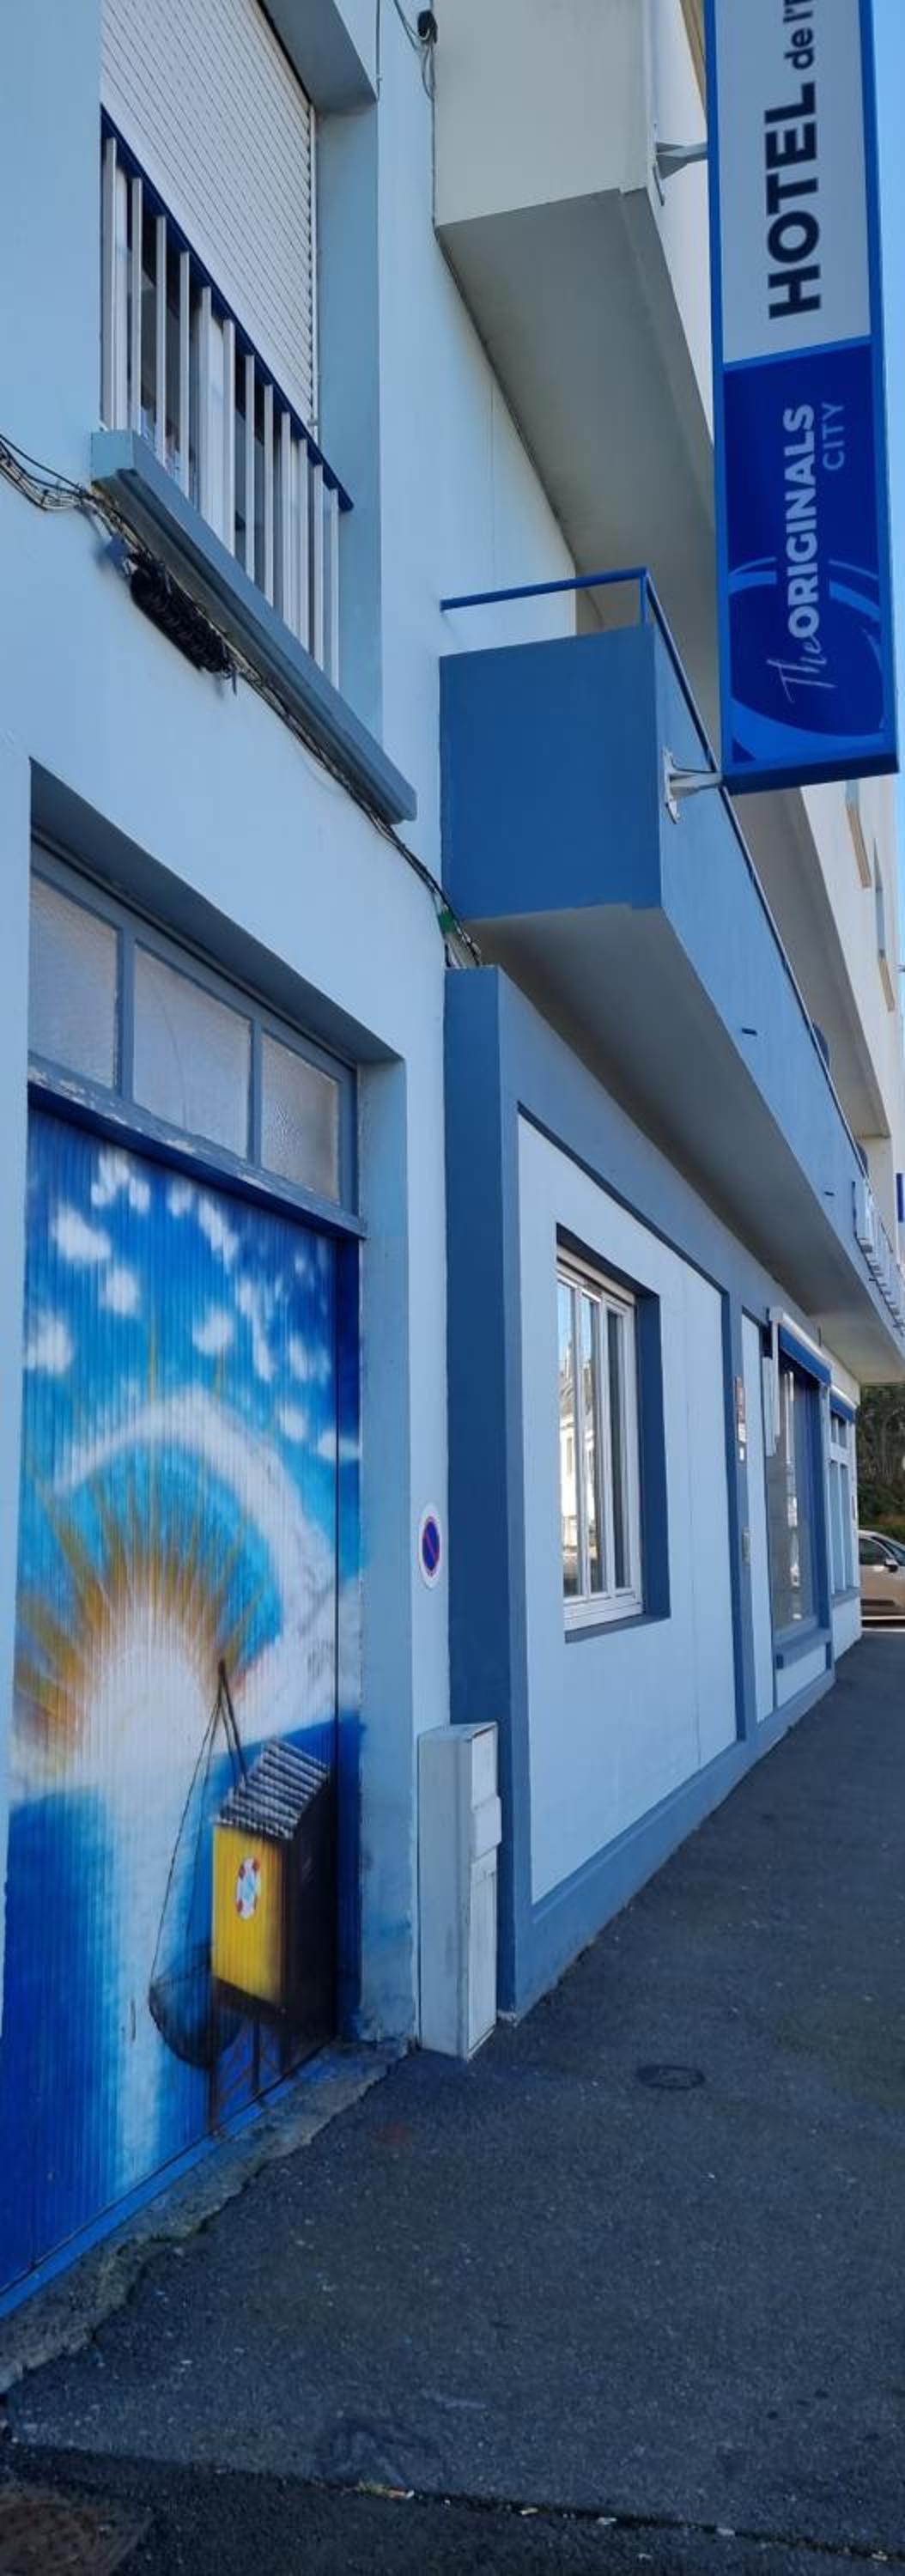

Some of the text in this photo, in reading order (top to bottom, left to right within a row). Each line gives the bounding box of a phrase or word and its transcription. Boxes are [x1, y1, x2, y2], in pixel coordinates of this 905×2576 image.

[784, 27, 815, 70] de
[764, 82, 821, 319] HOTEL
[822, 402, 845, 471] CITY
[767, 404, 836, 702] The ORIGINALS
